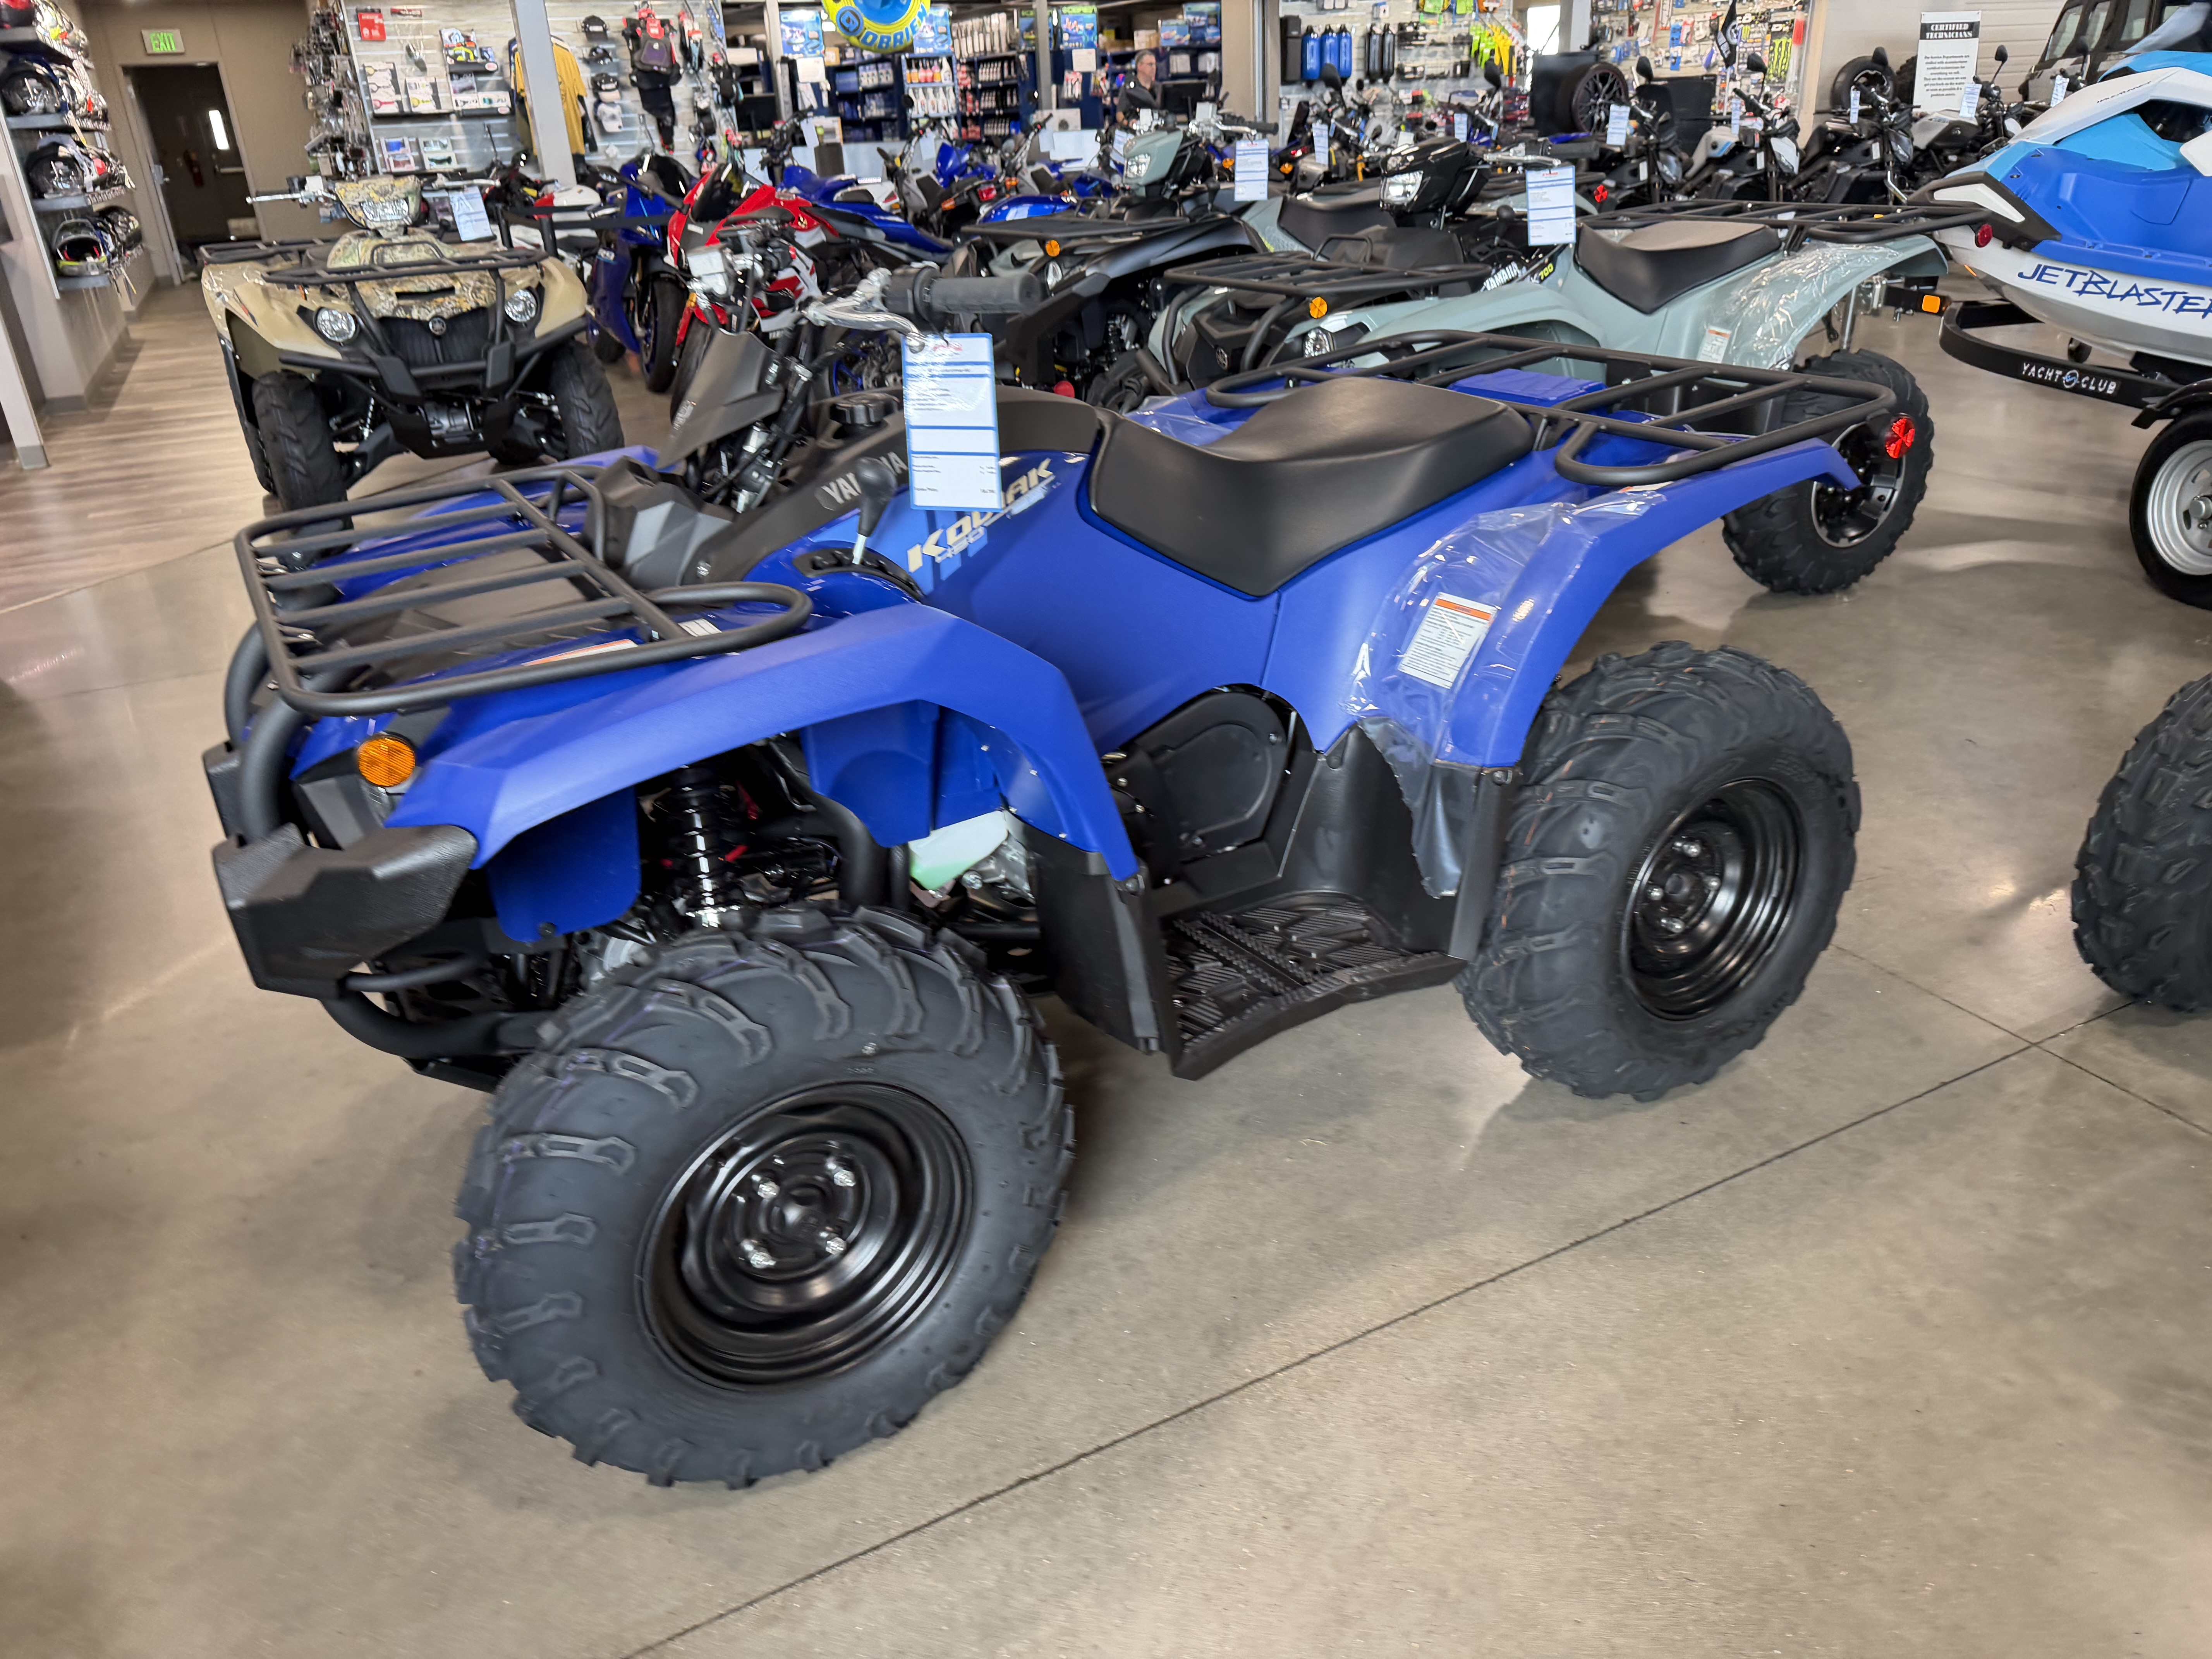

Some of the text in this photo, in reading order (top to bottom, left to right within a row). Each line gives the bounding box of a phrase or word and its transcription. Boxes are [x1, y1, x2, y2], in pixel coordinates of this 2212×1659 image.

[149, 33, 176, 52] EXIT
[1538, 263, 1554, 280] 700
[2022, 362, 2117, 394] YACHT CLUB
[821, 452, 908, 505] YAA
